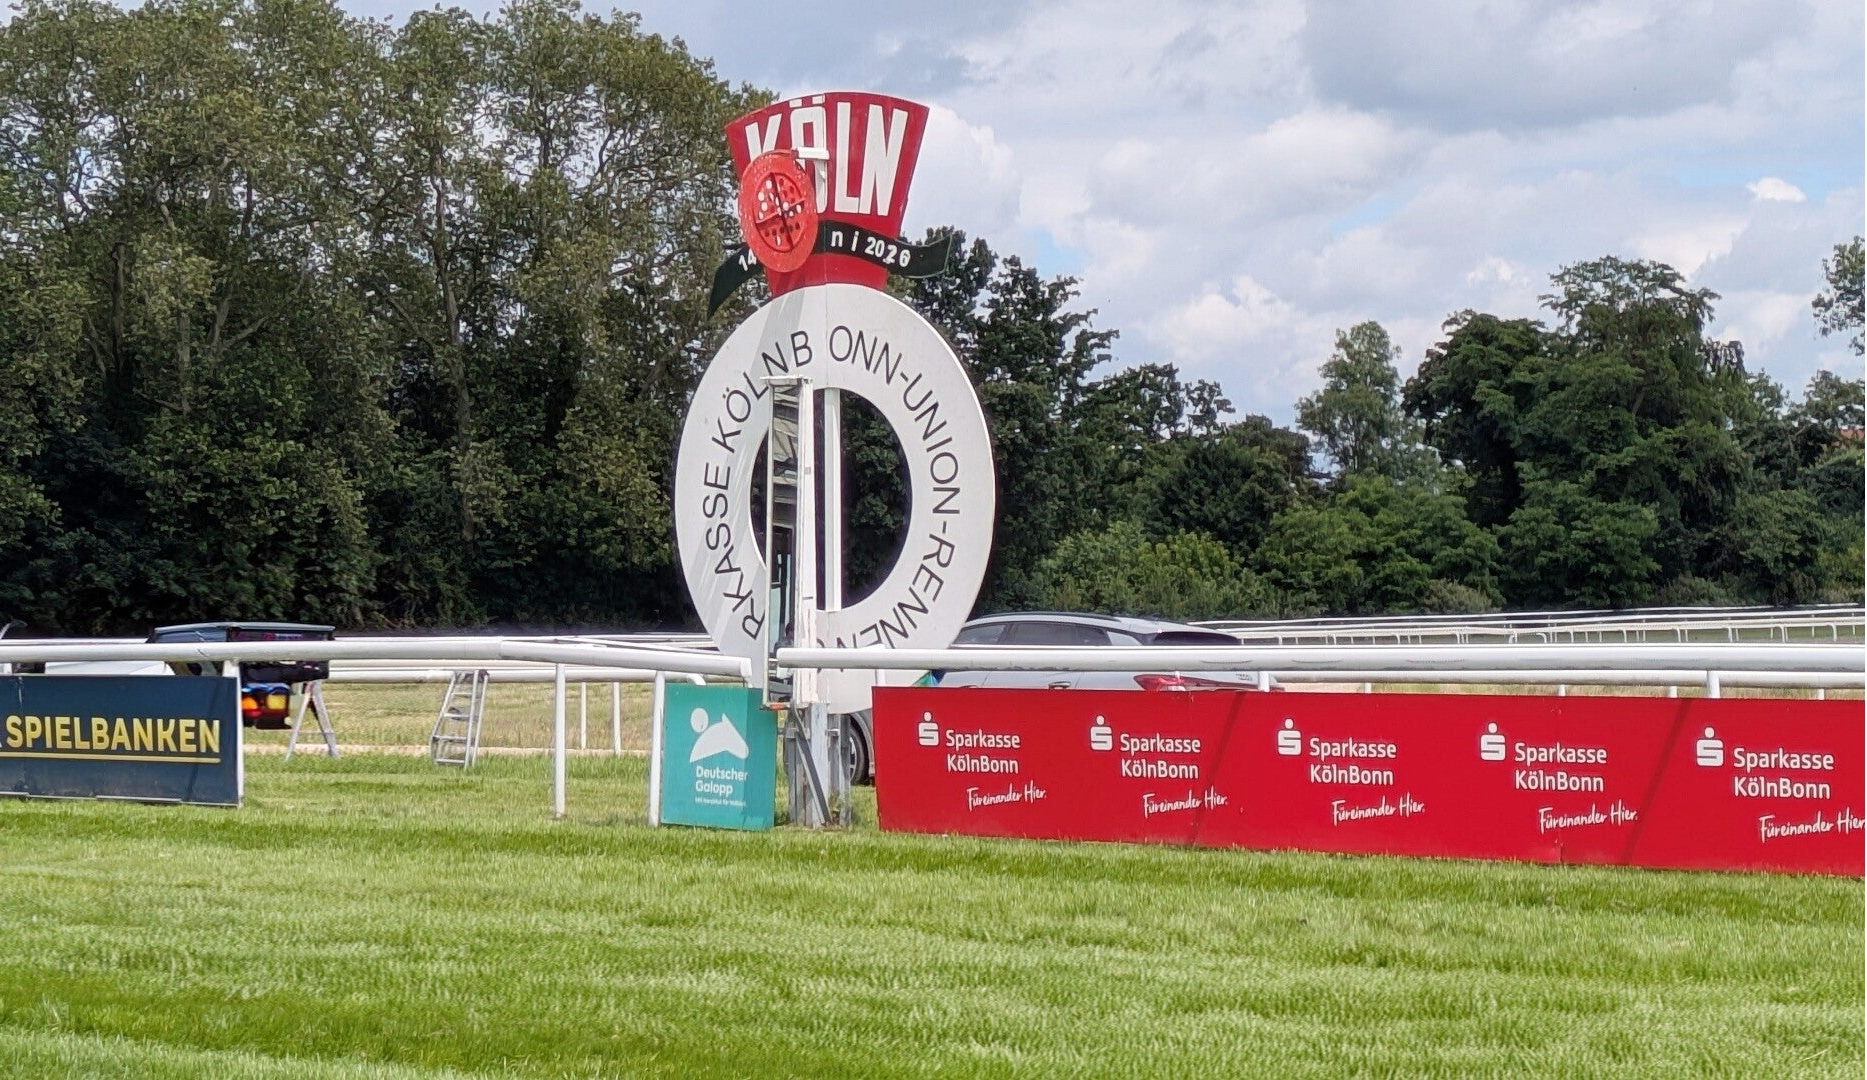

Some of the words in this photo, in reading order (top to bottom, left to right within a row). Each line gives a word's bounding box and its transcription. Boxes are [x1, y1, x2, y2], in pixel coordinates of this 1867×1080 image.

[6, 715, 219, 753] SPIELBANKEN
[945, 729, 1020, 752] Sparkasse
[1120, 733, 1201, 757] Sparkasse
[1309, 737, 1397, 762] Sparkasse
[1514, 742, 1607, 767] Sparkasse
[1733, 747, 1834, 773] Sparkasse
[696, 765, 748, 781] Deutscher
[947, 754, 1019, 774] KölnBonn
[1121, 758, 1199, 779] KölnBonn
[1310, 763, 1394, 786] KölnBonn
[696, 780, 734, 797] Galopp
[1515, 769, 1604, 792] KölnBonn
[1734, 776, 1831, 800] KölnBonn
[966, 784, 1022, 811] Füreinander
[1024, 780, 1047, 803] Hier.
[1142, 789, 1202, 818] Füreinander
[1204, 785, 1228, 809] Hier.
[1331, 796, 1396, 826] Füreinander
[1399, 792, 1426, 818] Hier.
[1538, 803, 1608, 834] Füreinander
[1610, 799, 1638, 826] Hier.
[1759, 811, 1834, 843] Füreinander
